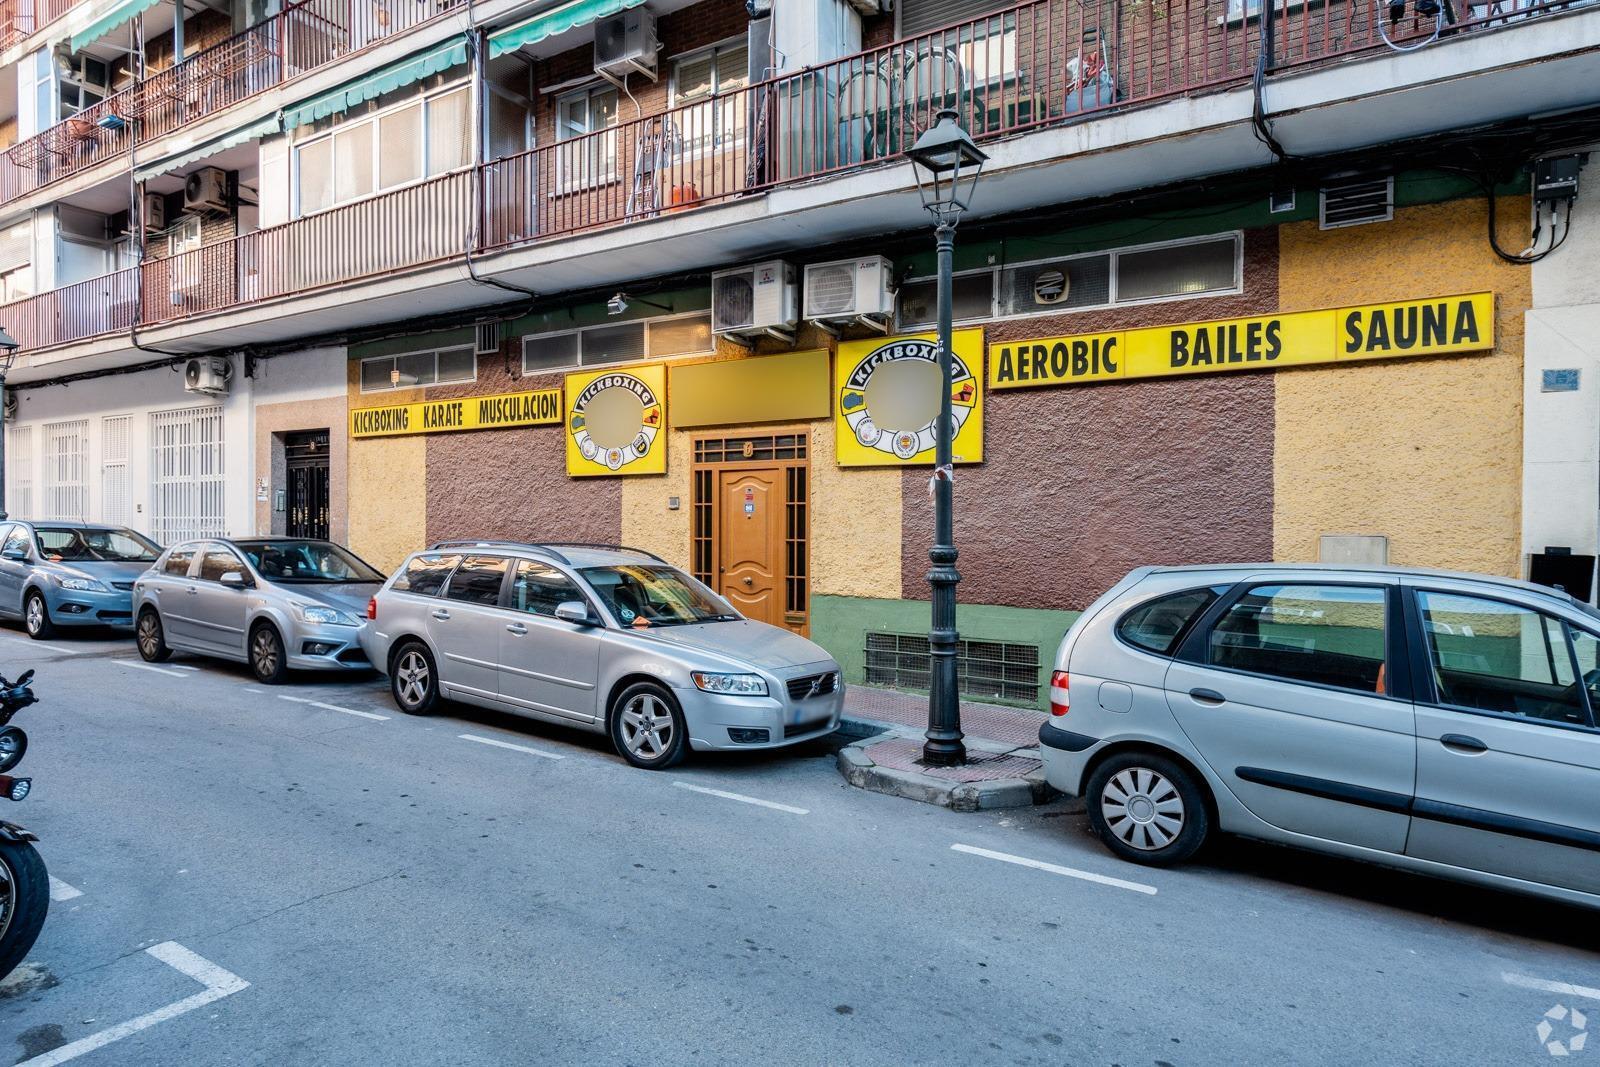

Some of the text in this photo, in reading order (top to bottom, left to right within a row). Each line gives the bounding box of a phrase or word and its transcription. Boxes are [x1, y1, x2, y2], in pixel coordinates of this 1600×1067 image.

[997, 300, 1480, 382] AEROBIC BAILES SAUNA
[855, 344, 961, 384] KICKBOXIG
[579, 376, 651, 407] KICKBOXING
[353, 393, 557, 433] KICKBOXING KARATE MUSCULACION
